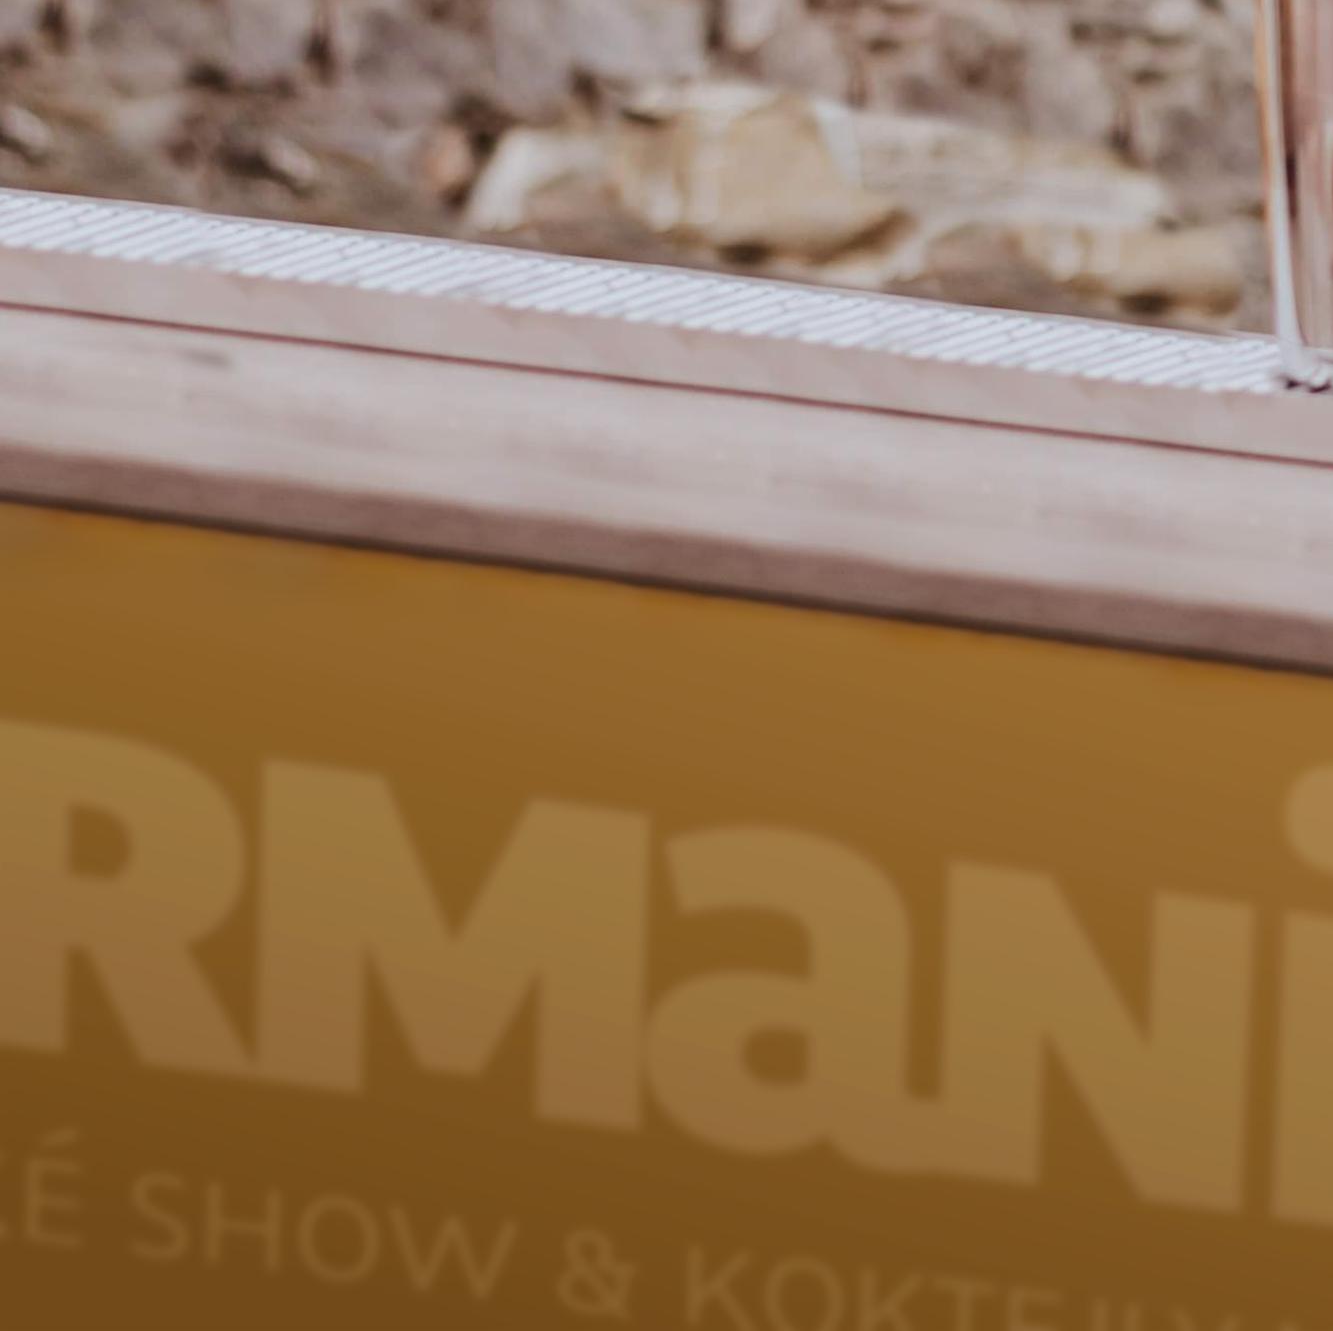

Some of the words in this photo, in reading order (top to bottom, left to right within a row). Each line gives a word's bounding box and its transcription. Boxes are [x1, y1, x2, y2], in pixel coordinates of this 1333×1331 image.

[0, 1126, 86, 1251] É
[127, 1169, 520, 1301] SHOW
[554, 1226, 639, 1322] &
